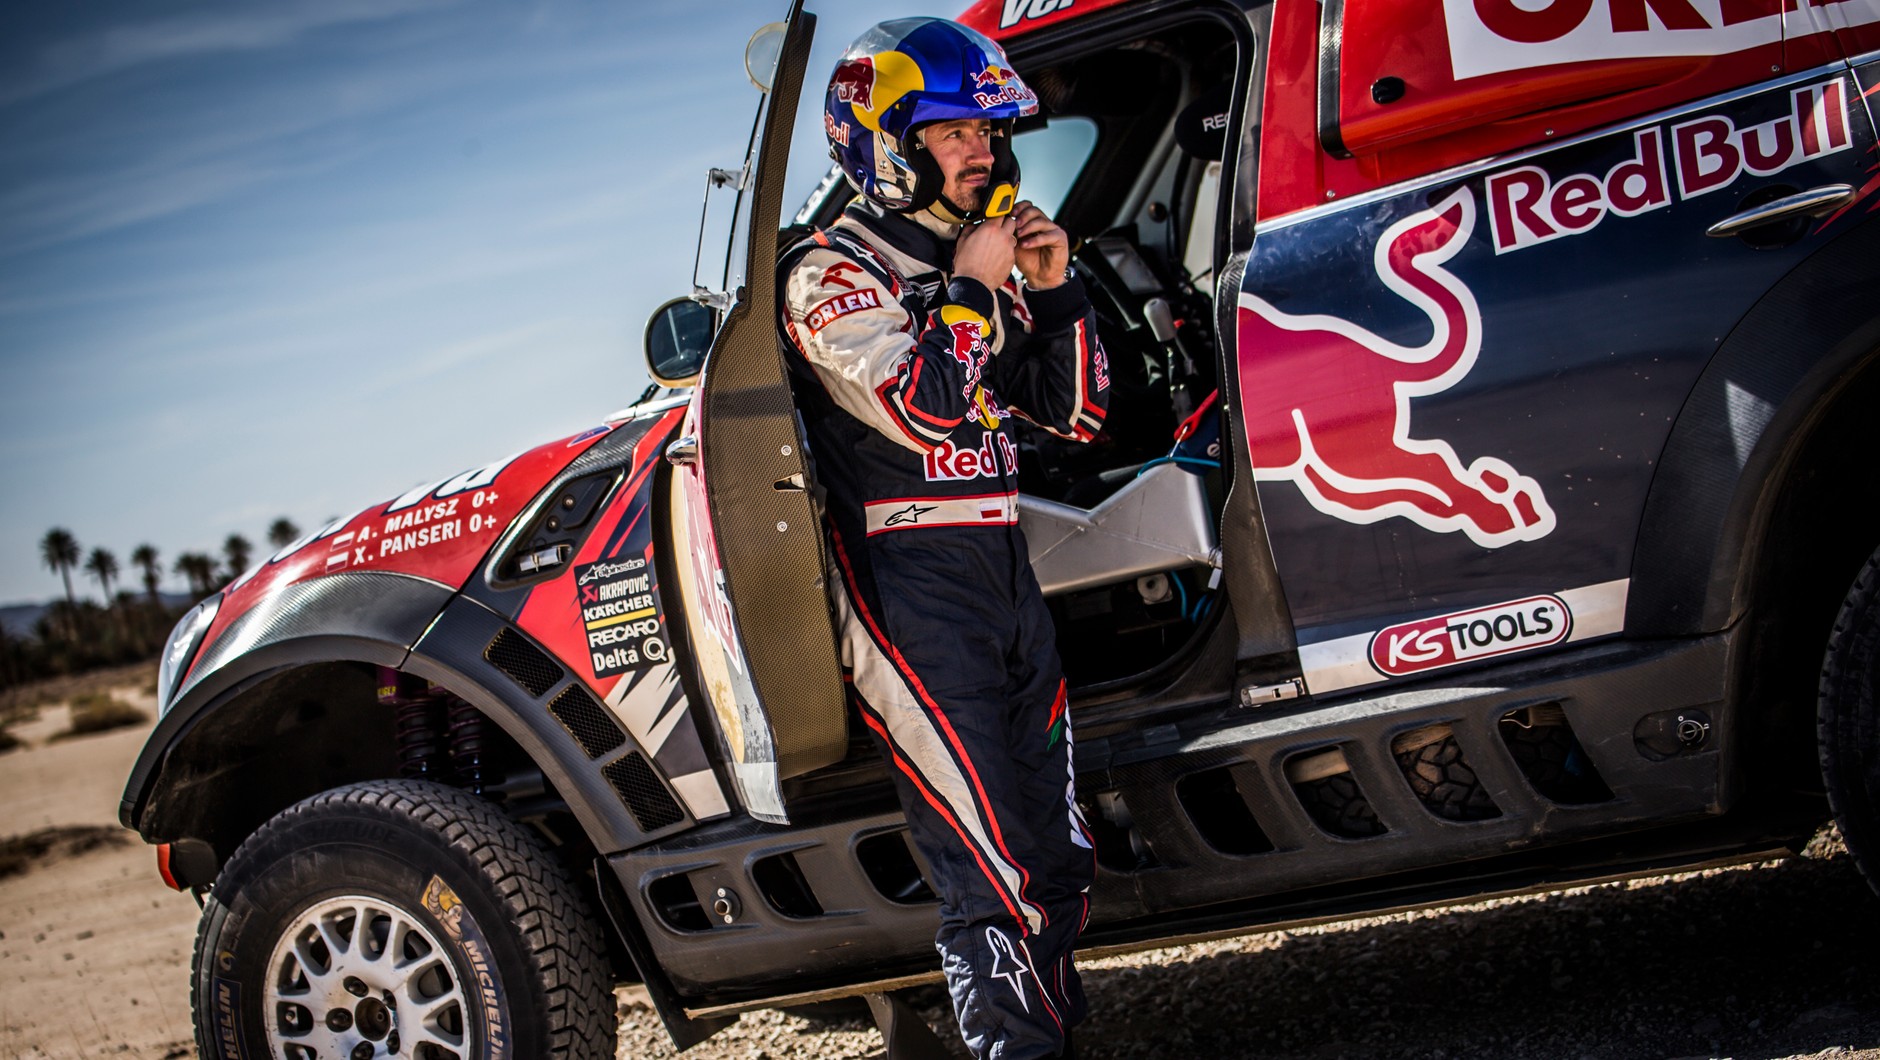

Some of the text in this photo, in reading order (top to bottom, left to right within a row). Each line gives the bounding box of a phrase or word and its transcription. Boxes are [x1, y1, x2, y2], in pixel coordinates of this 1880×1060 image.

[973, 86, 1014, 111] Red
[827, 113, 850, 147] Bull
[1485, 77, 1853, 255] Red Bull
[809, 291, 877, 330] ORLEN
[977, 341, 991, 367] ull
[923, 431, 999, 481] Red
[357, 526, 377, 542] A.
[384, 498, 459, 534] MALYSZ
[353, 547, 373, 565] X.
[380, 519, 461, 557] PANSERI
[599, 558, 645, 578] alpinestars
[588, 618, 660, 648] RECARO
[593, 648, 639, 672] Delta
[219, 982, 239, 1060] HELIN
